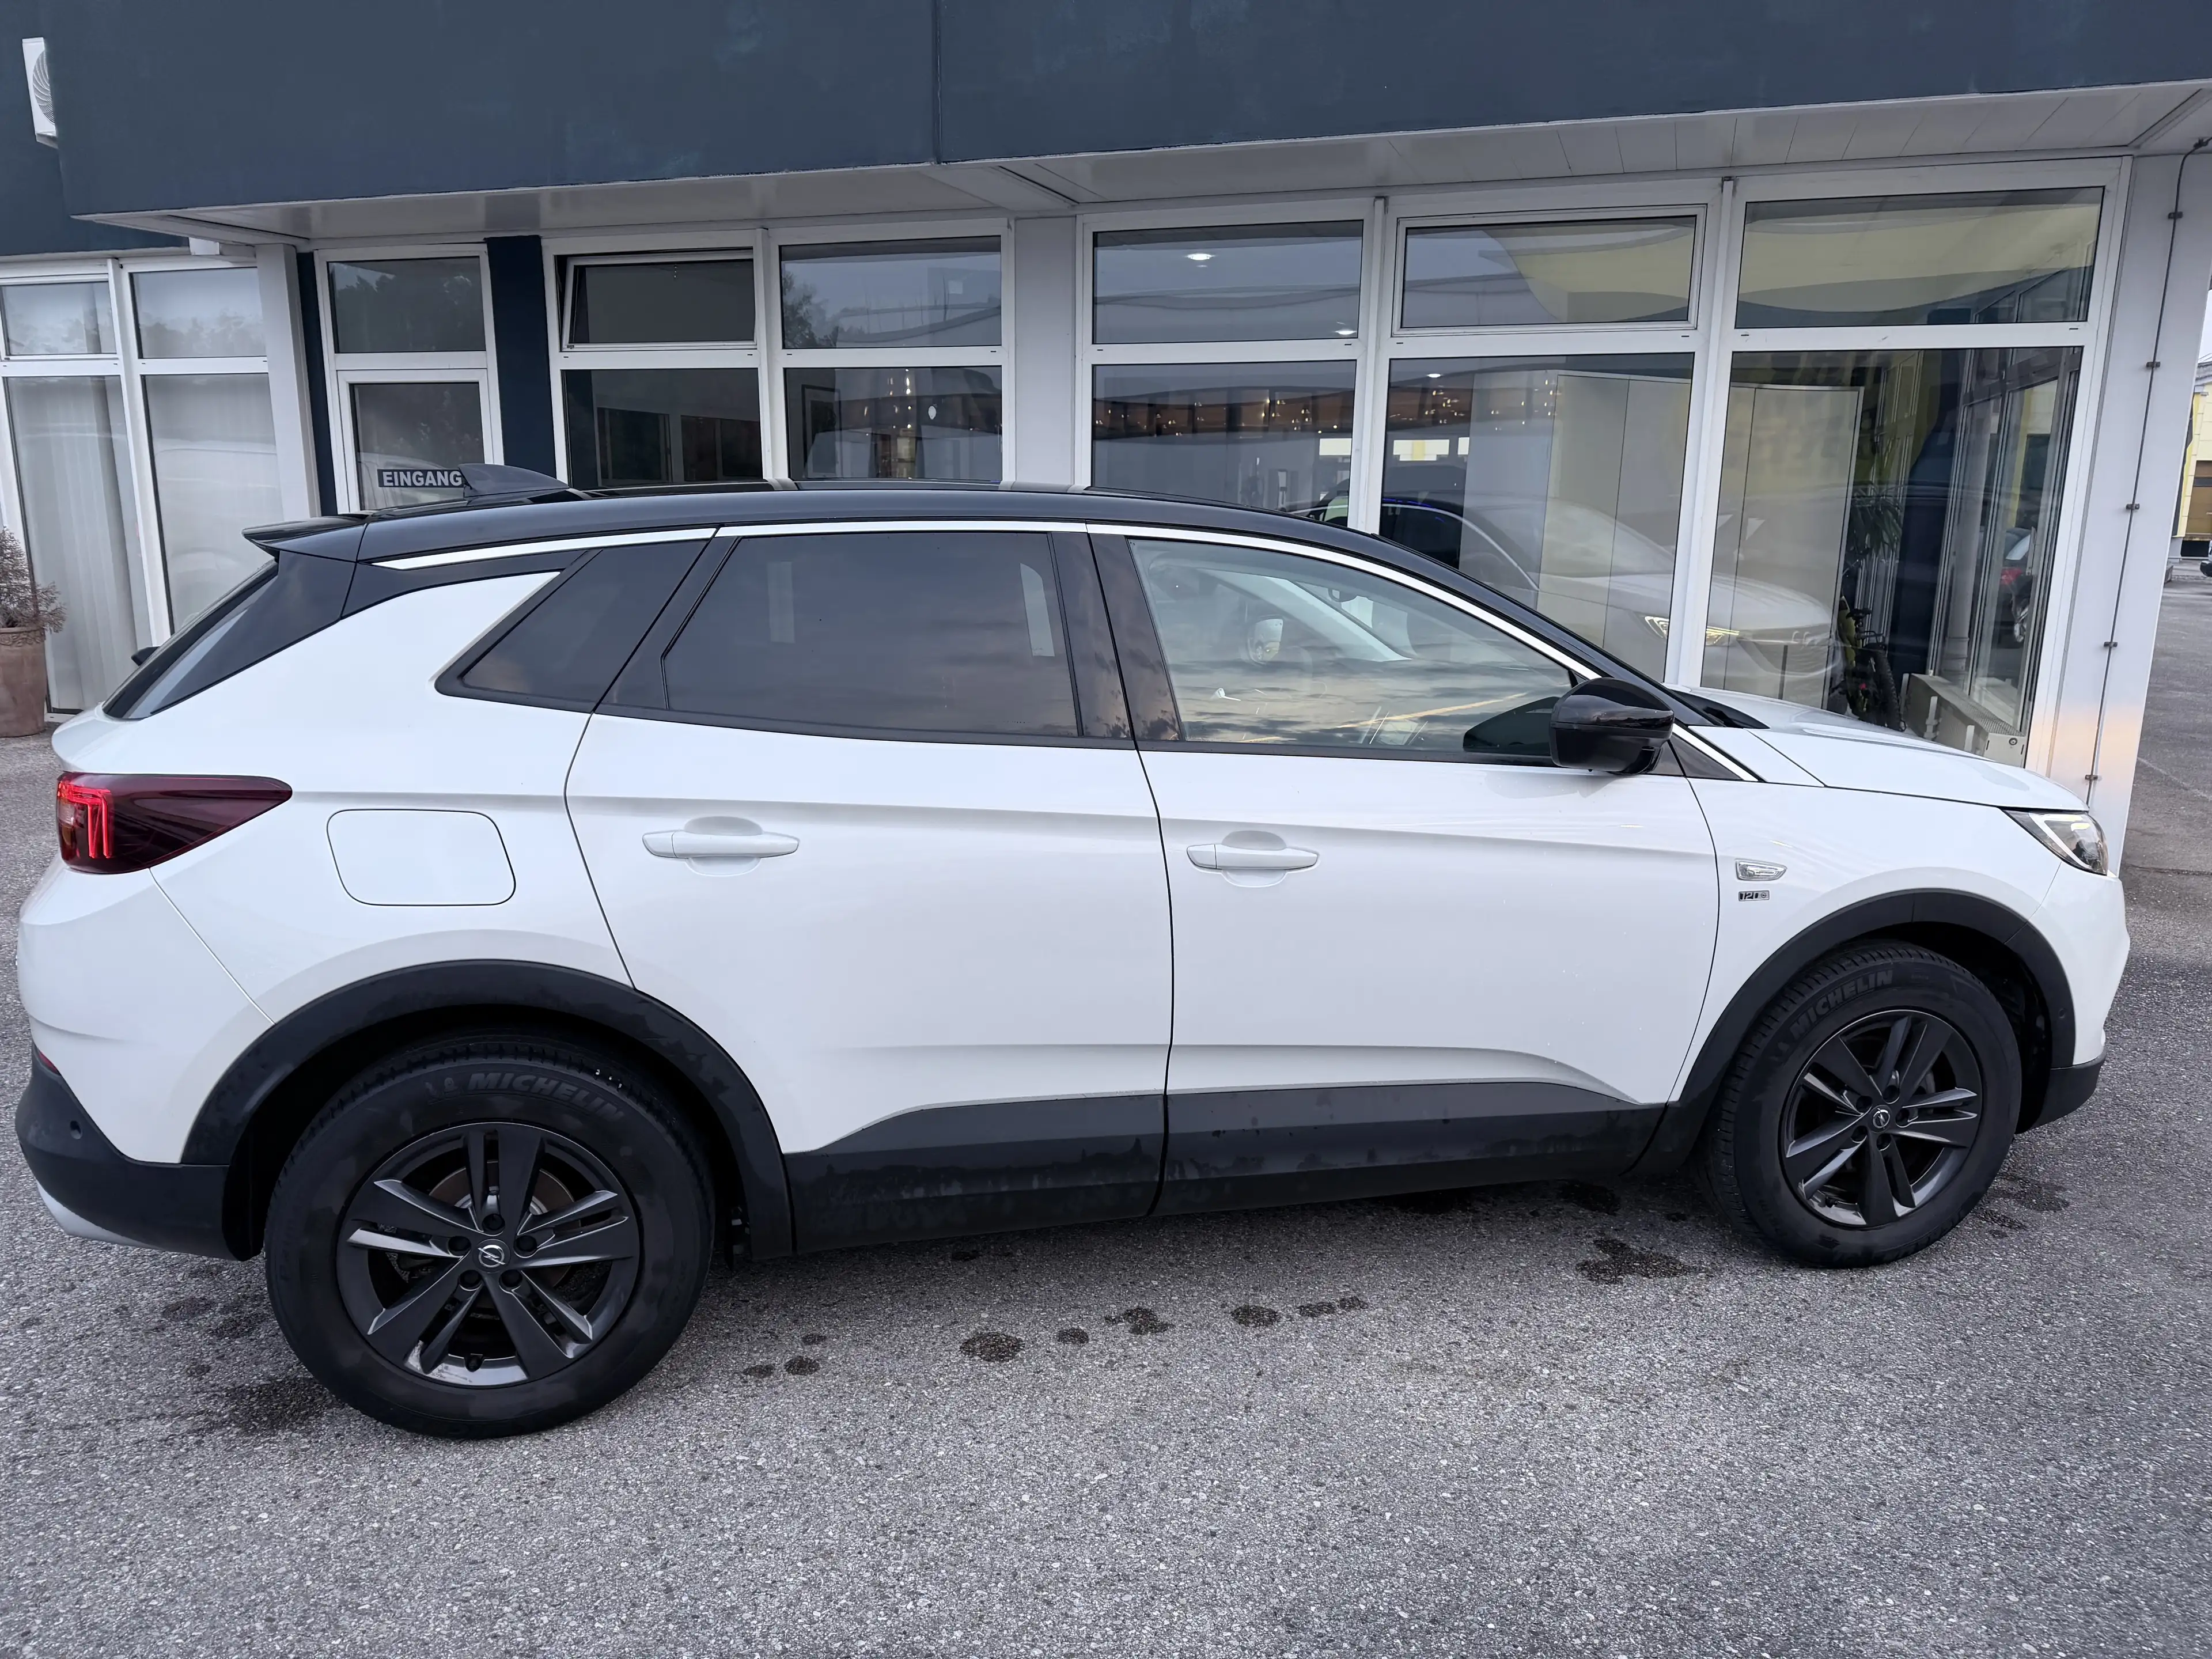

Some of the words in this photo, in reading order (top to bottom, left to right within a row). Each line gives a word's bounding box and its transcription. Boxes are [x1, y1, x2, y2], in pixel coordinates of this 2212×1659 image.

[382, 471, 462, 486] EINGANG
[1789, 969, 1893, 1040] MICHELIN
[468, 1073, 626, 1122] MICHELIN
